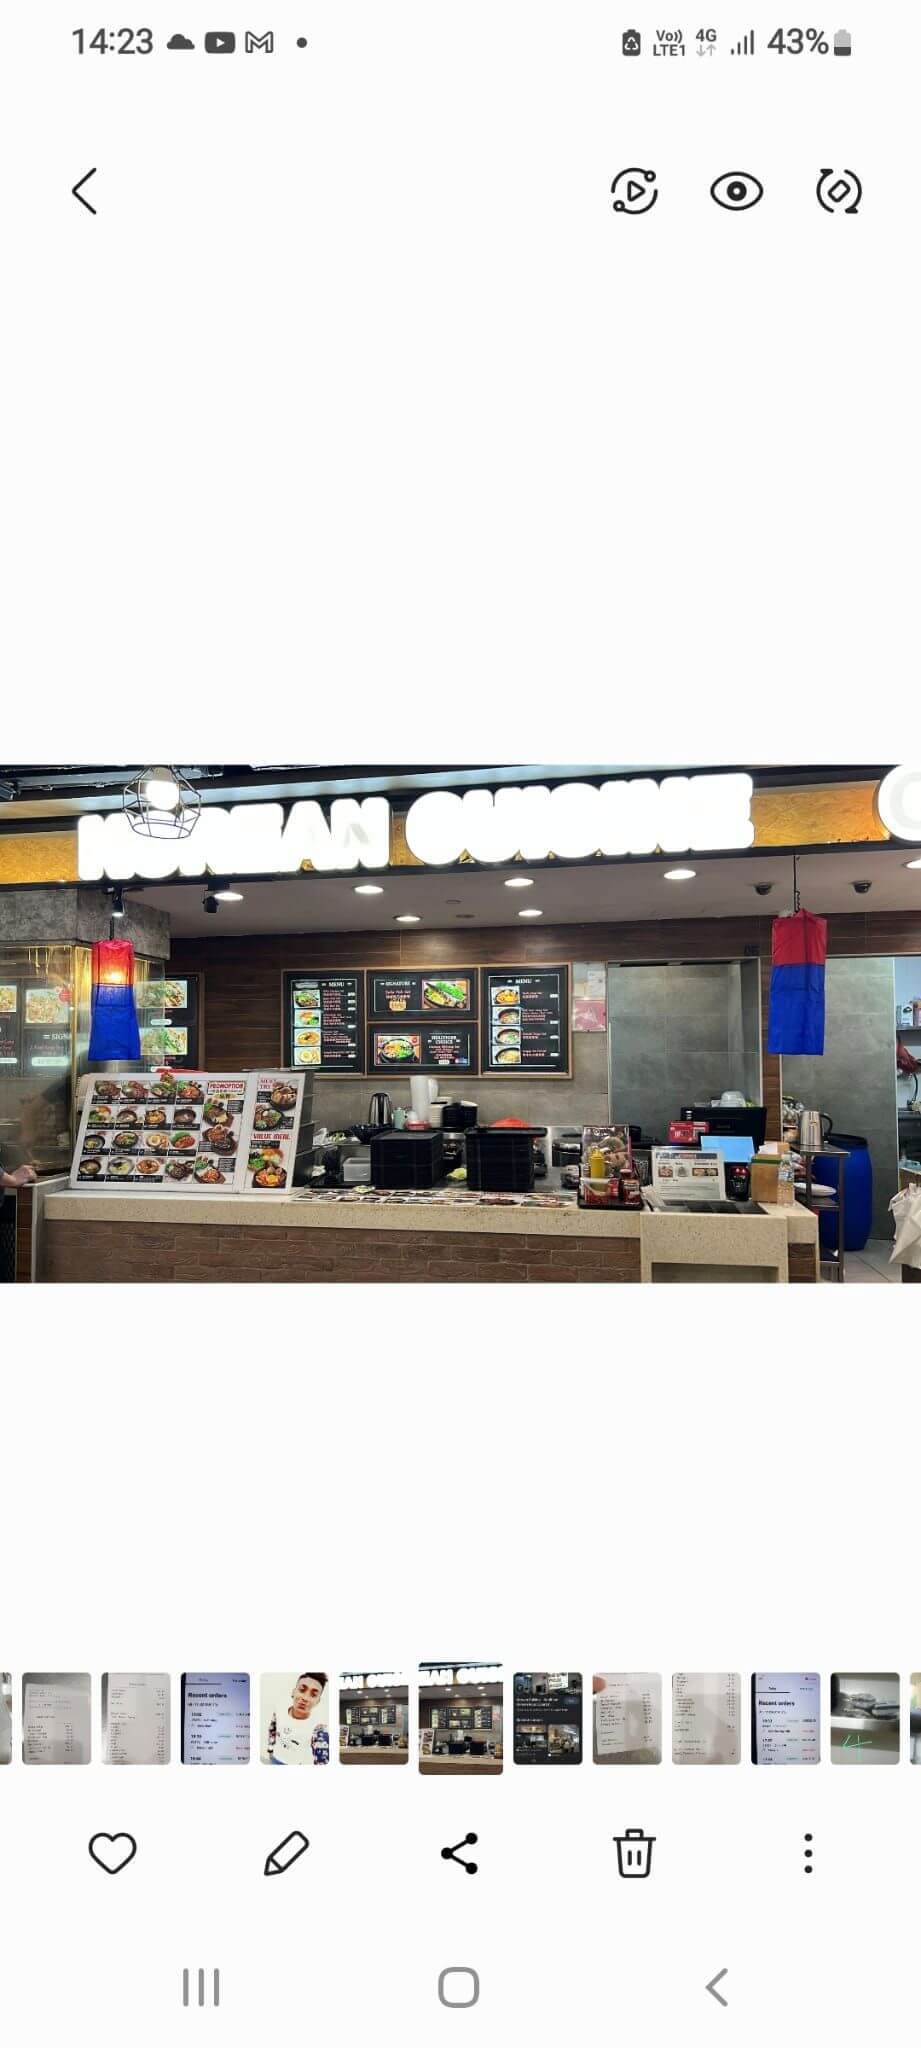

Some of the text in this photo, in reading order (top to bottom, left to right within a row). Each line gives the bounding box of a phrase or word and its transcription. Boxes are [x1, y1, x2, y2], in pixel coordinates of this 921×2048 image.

[73, 28, 153, 54] 14:23
[696, 29, 717, 43] 4G
[767, 28, 829, 54] 43%
[653, 44, 685, 57] LTE1
